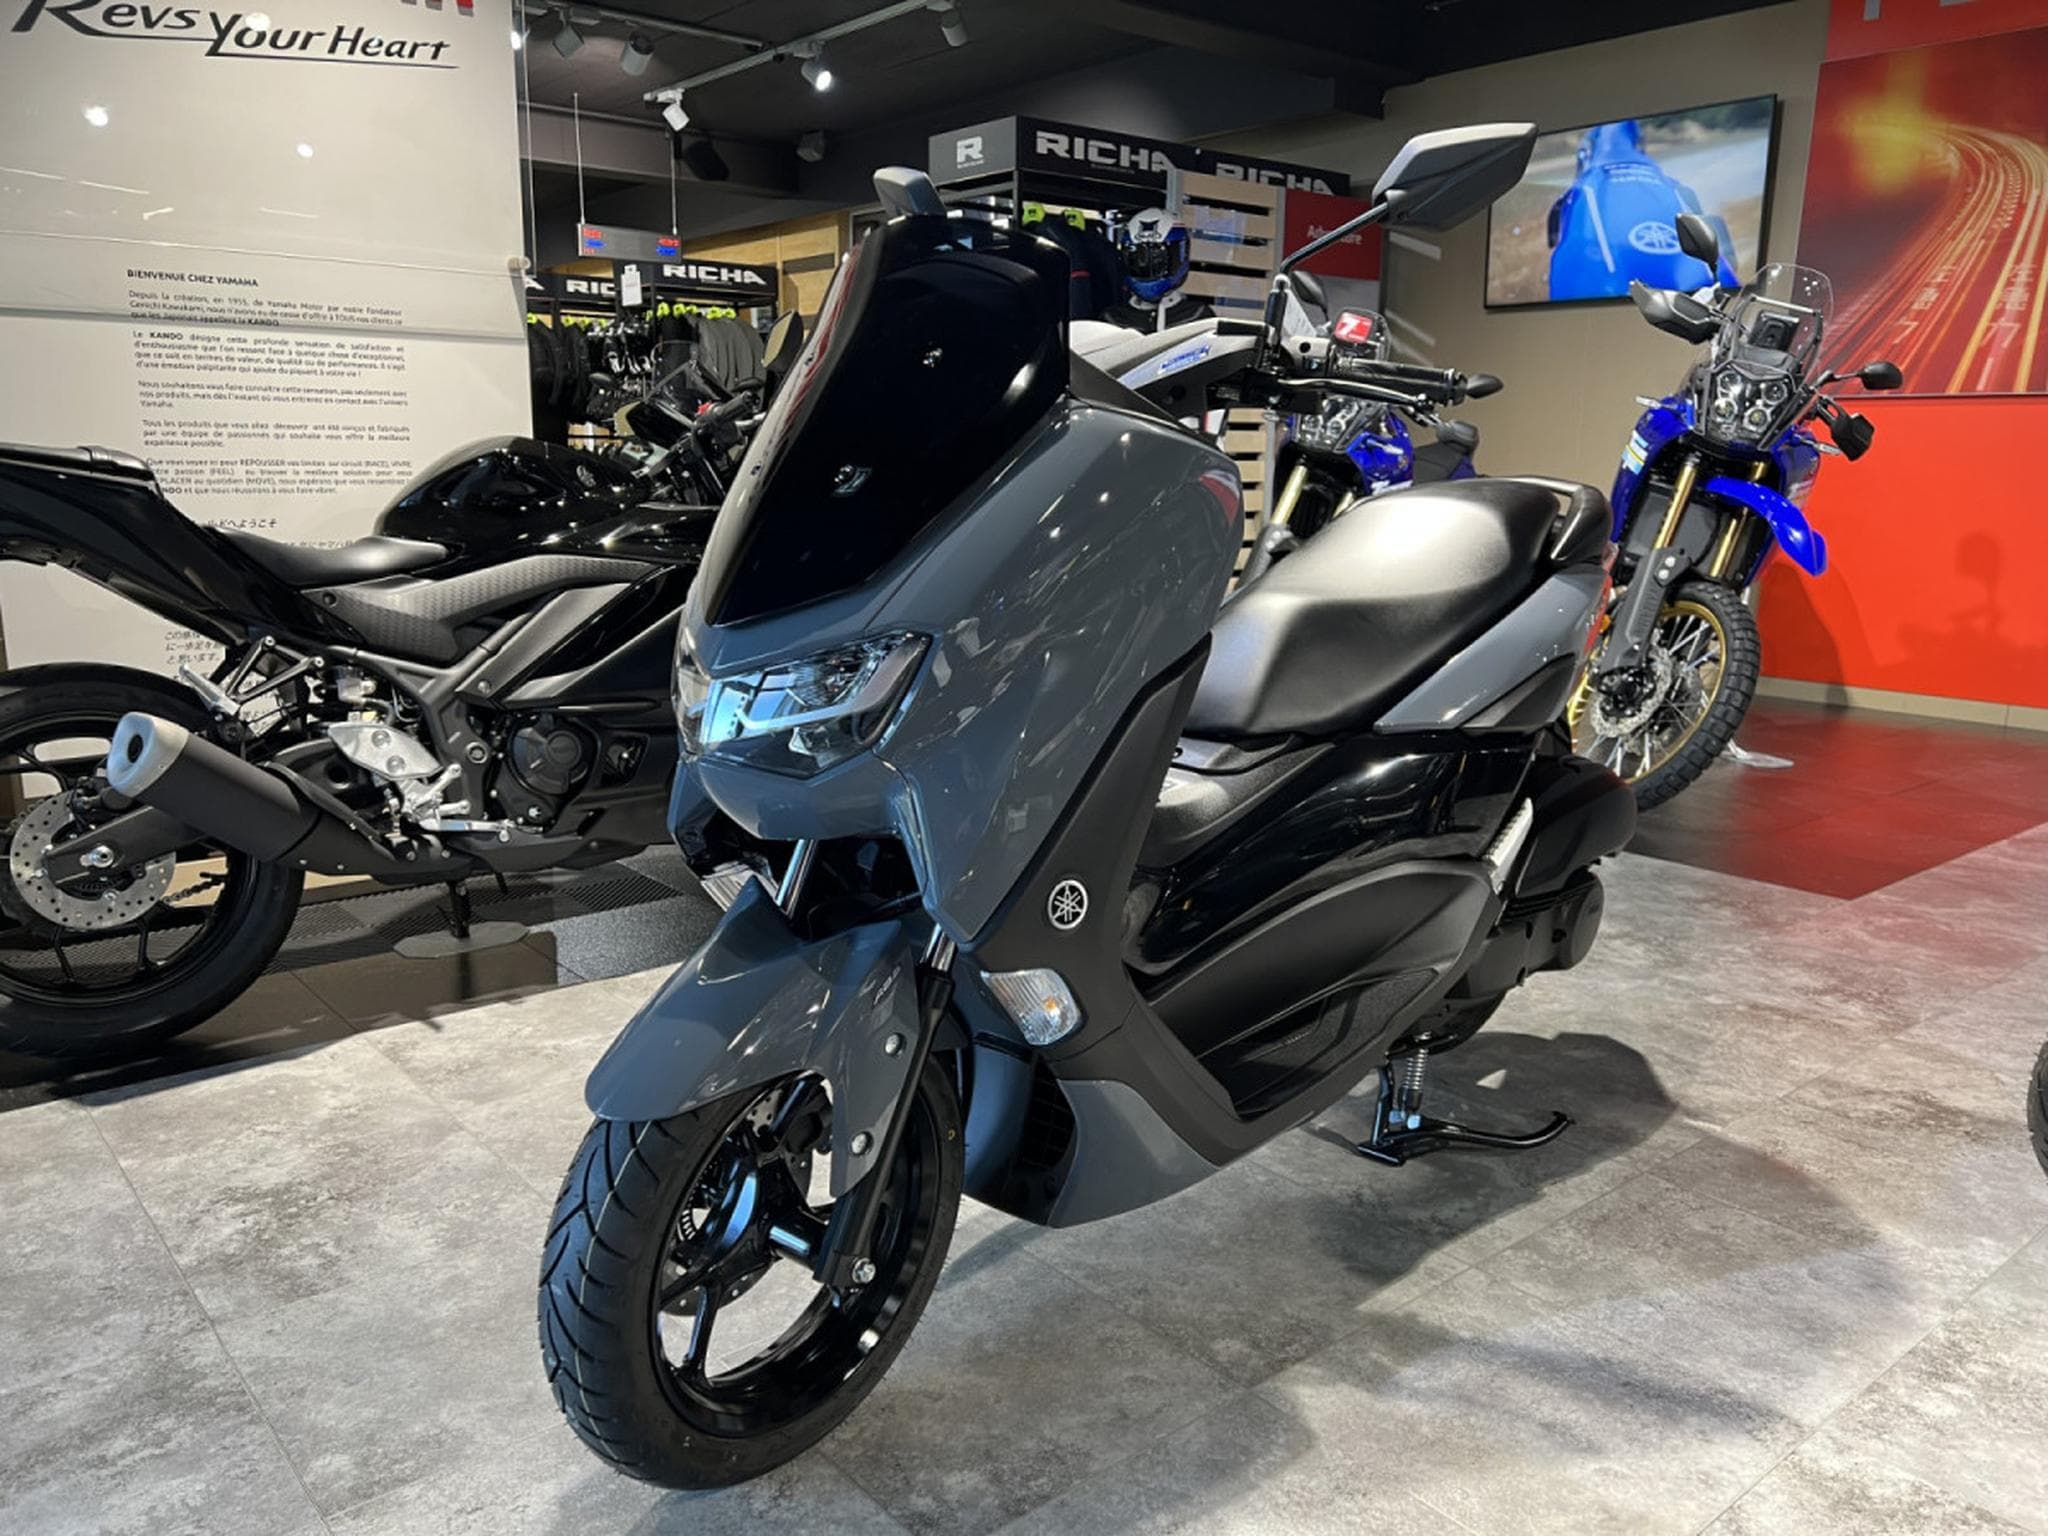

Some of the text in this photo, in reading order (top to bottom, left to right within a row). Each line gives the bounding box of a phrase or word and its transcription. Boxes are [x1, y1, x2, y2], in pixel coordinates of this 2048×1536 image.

[11, 0, 450, 60] Revs Your Heart
[956, 136, 984, 163] R
[1036, 130, 1168, 172] RICHA
[662, 263, 767, 286] RICHA
[566, 279, 616, 297] RIC
[161, 476, 192, 484] PLACER
